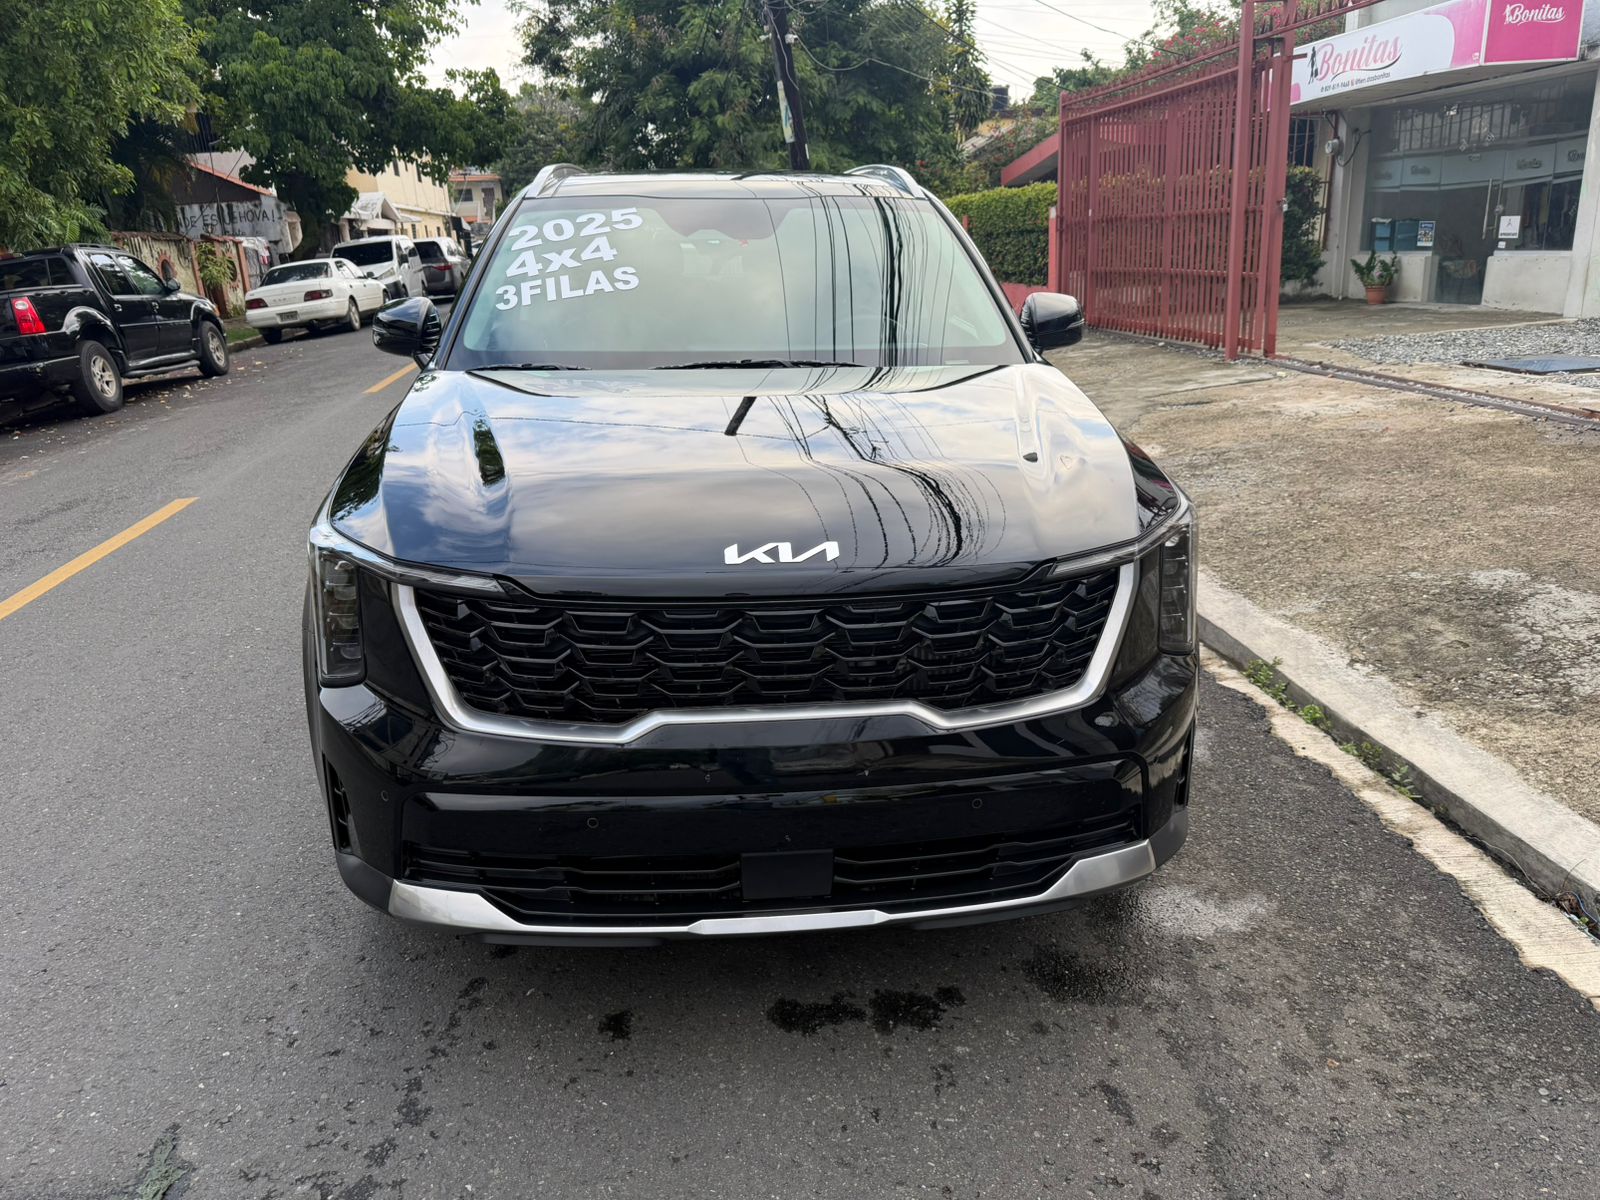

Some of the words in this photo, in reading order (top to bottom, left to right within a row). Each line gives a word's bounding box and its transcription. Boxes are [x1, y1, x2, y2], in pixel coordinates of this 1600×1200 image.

[1508, 3, 1565, 24] Bonitas
[1316, 35, 1401, 81] Bonitas
[508, 207, 643, 251] 2025
[505, 236, 618, 278] 4x4
[495, 266, 640, 311] 3FILAS
[724, 541, 840, 564] KIA
